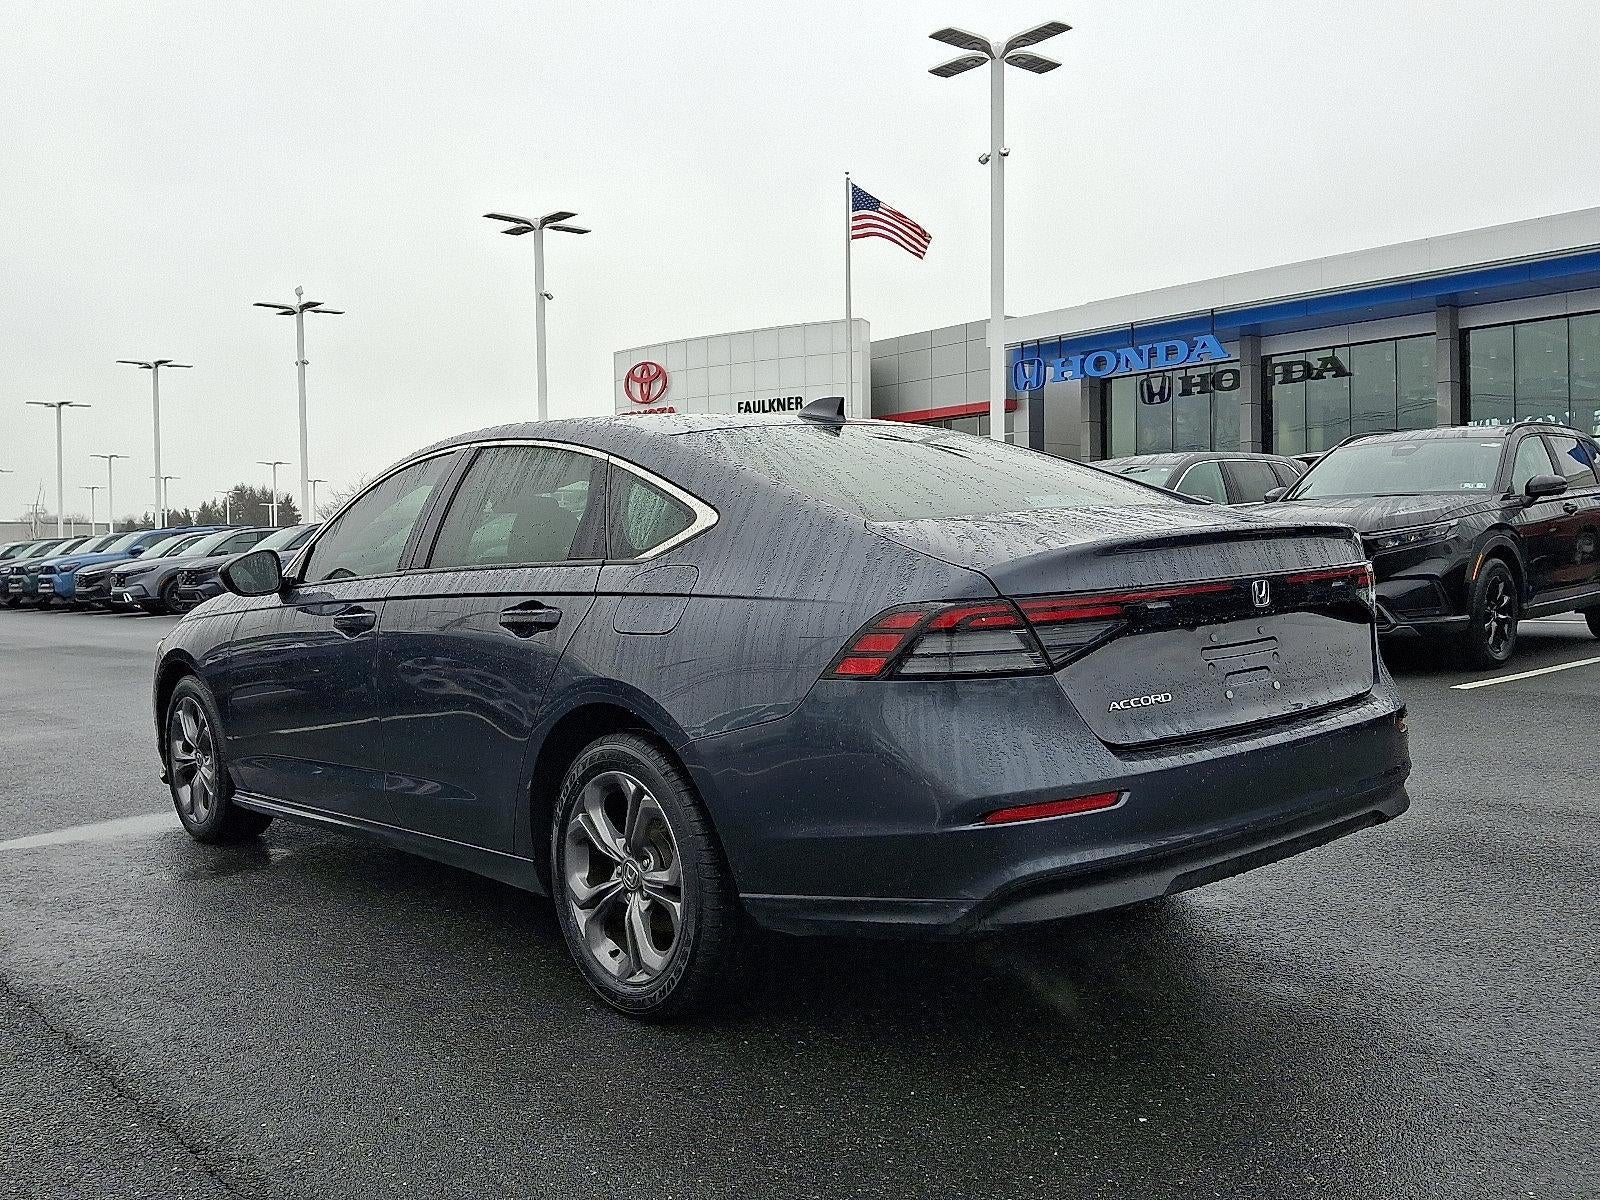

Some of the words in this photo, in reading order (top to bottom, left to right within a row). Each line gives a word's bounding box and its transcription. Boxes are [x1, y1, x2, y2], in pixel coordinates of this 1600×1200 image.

[1051, 334, 1231, 384] HONDA
[1178, 355, 1352, 397] HODA
[737, 396, 804, 414] FAULKNER
[1108, 692, 1173, 711] ACCORD
